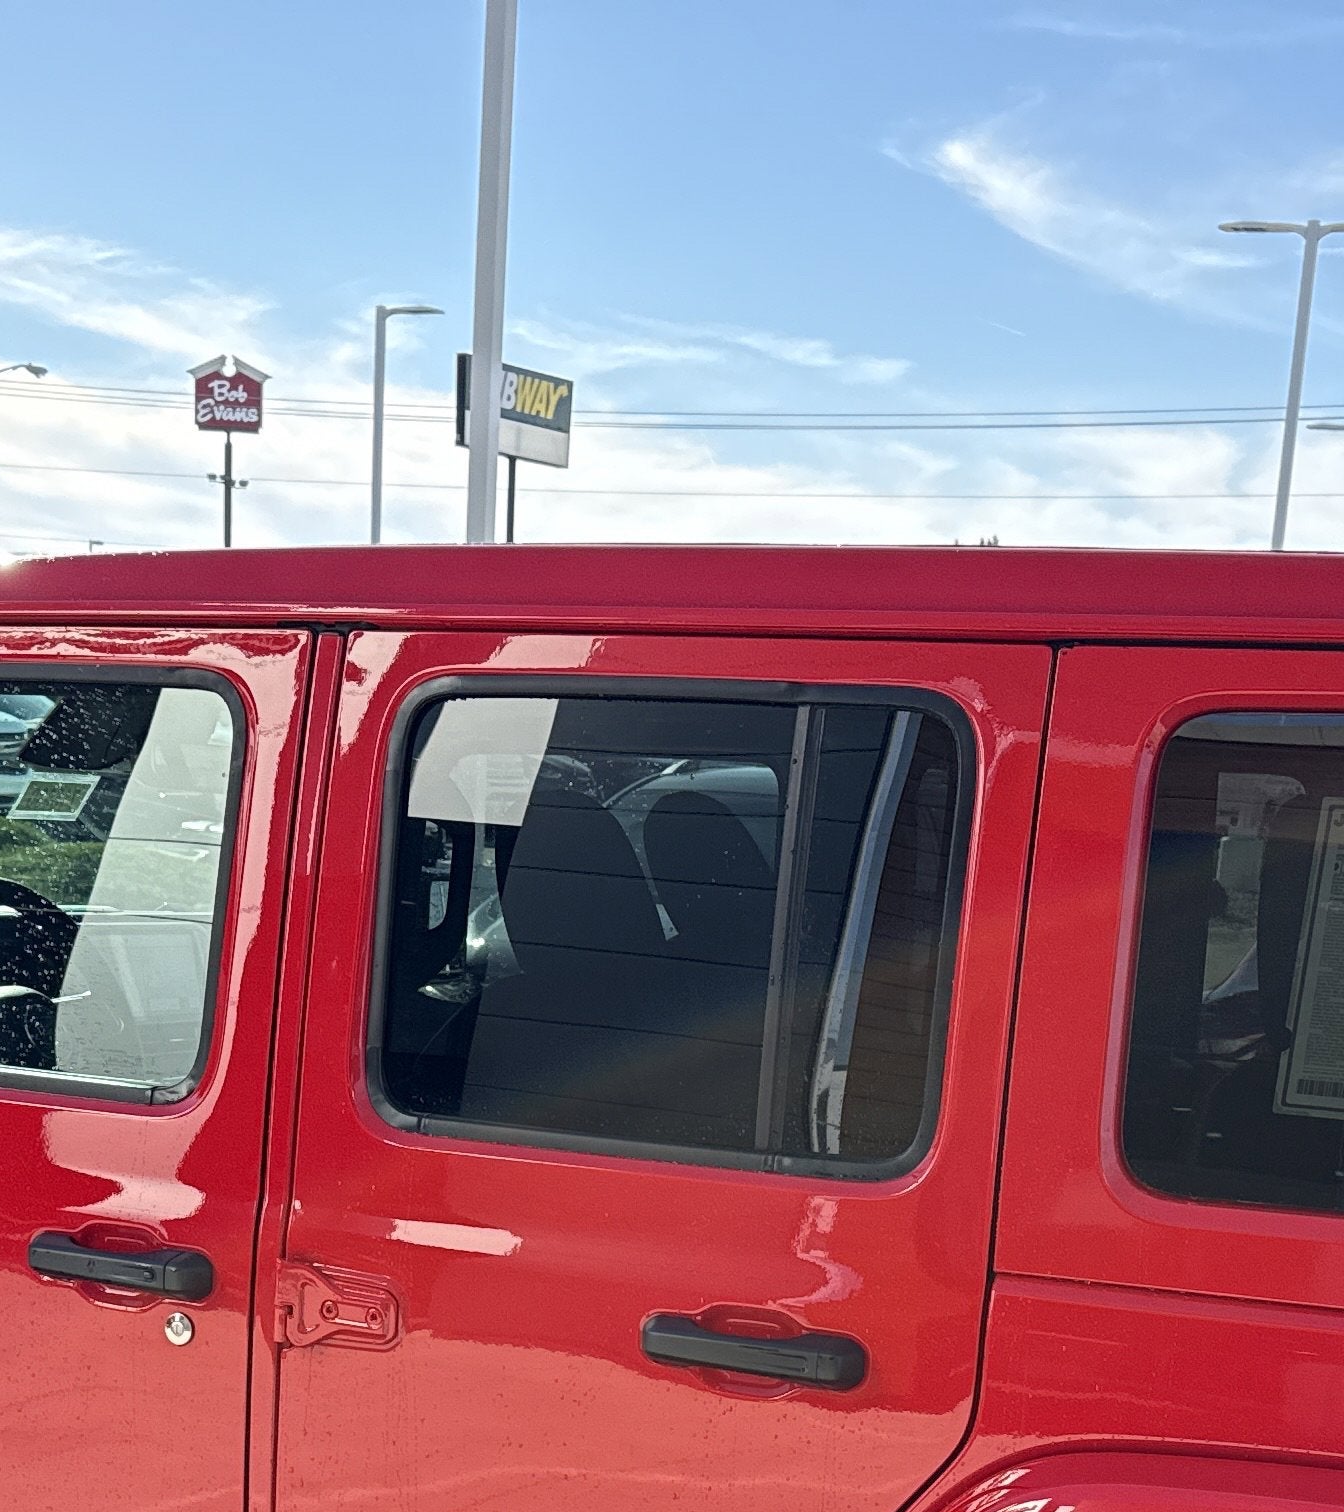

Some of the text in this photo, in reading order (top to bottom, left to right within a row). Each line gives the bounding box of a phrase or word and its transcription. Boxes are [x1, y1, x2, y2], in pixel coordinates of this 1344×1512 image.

[208, 380, 248, 402] Bob
[500, 371, 569, 420] BWAY
[197, 398, 259, 423] Evans
